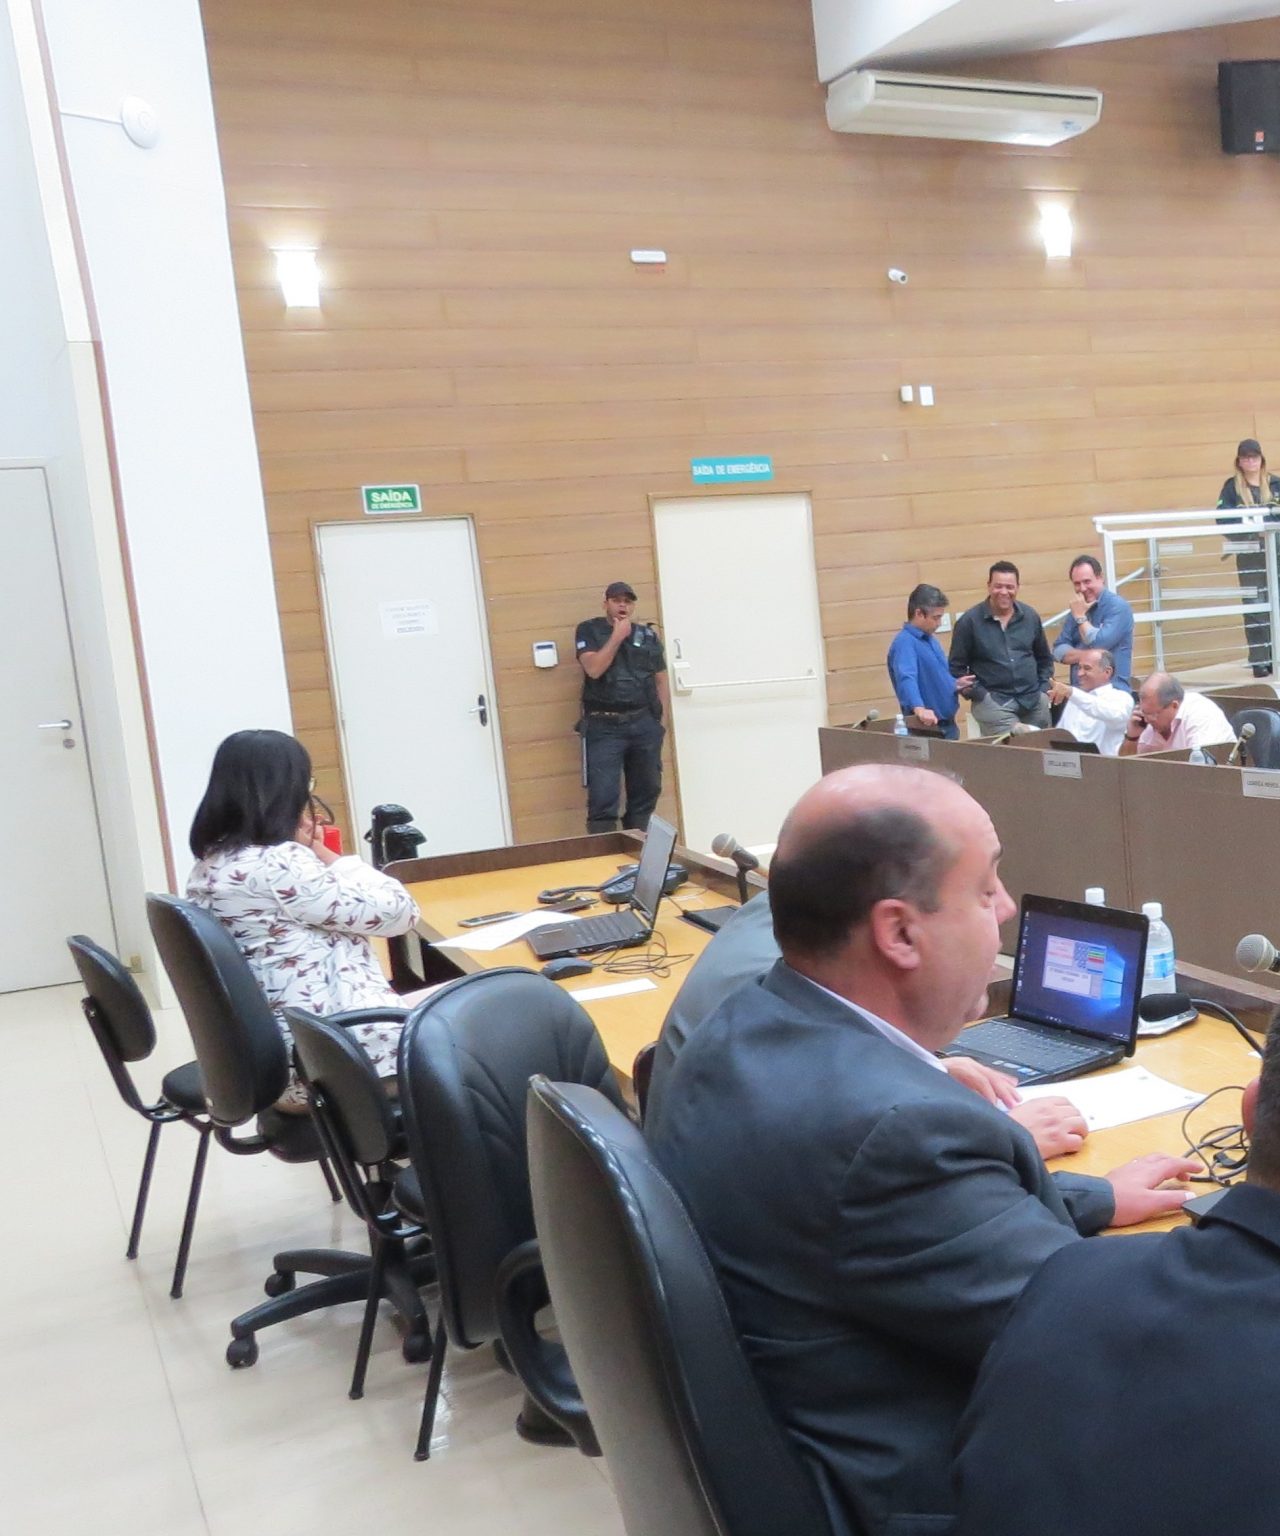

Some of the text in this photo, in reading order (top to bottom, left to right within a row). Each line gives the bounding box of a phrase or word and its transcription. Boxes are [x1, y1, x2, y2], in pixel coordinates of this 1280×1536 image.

[693, 464, 714, 476] SAÍDA
[715, 464, 726, 475] DE
[371, 488, 413, 503] SAÍDA
